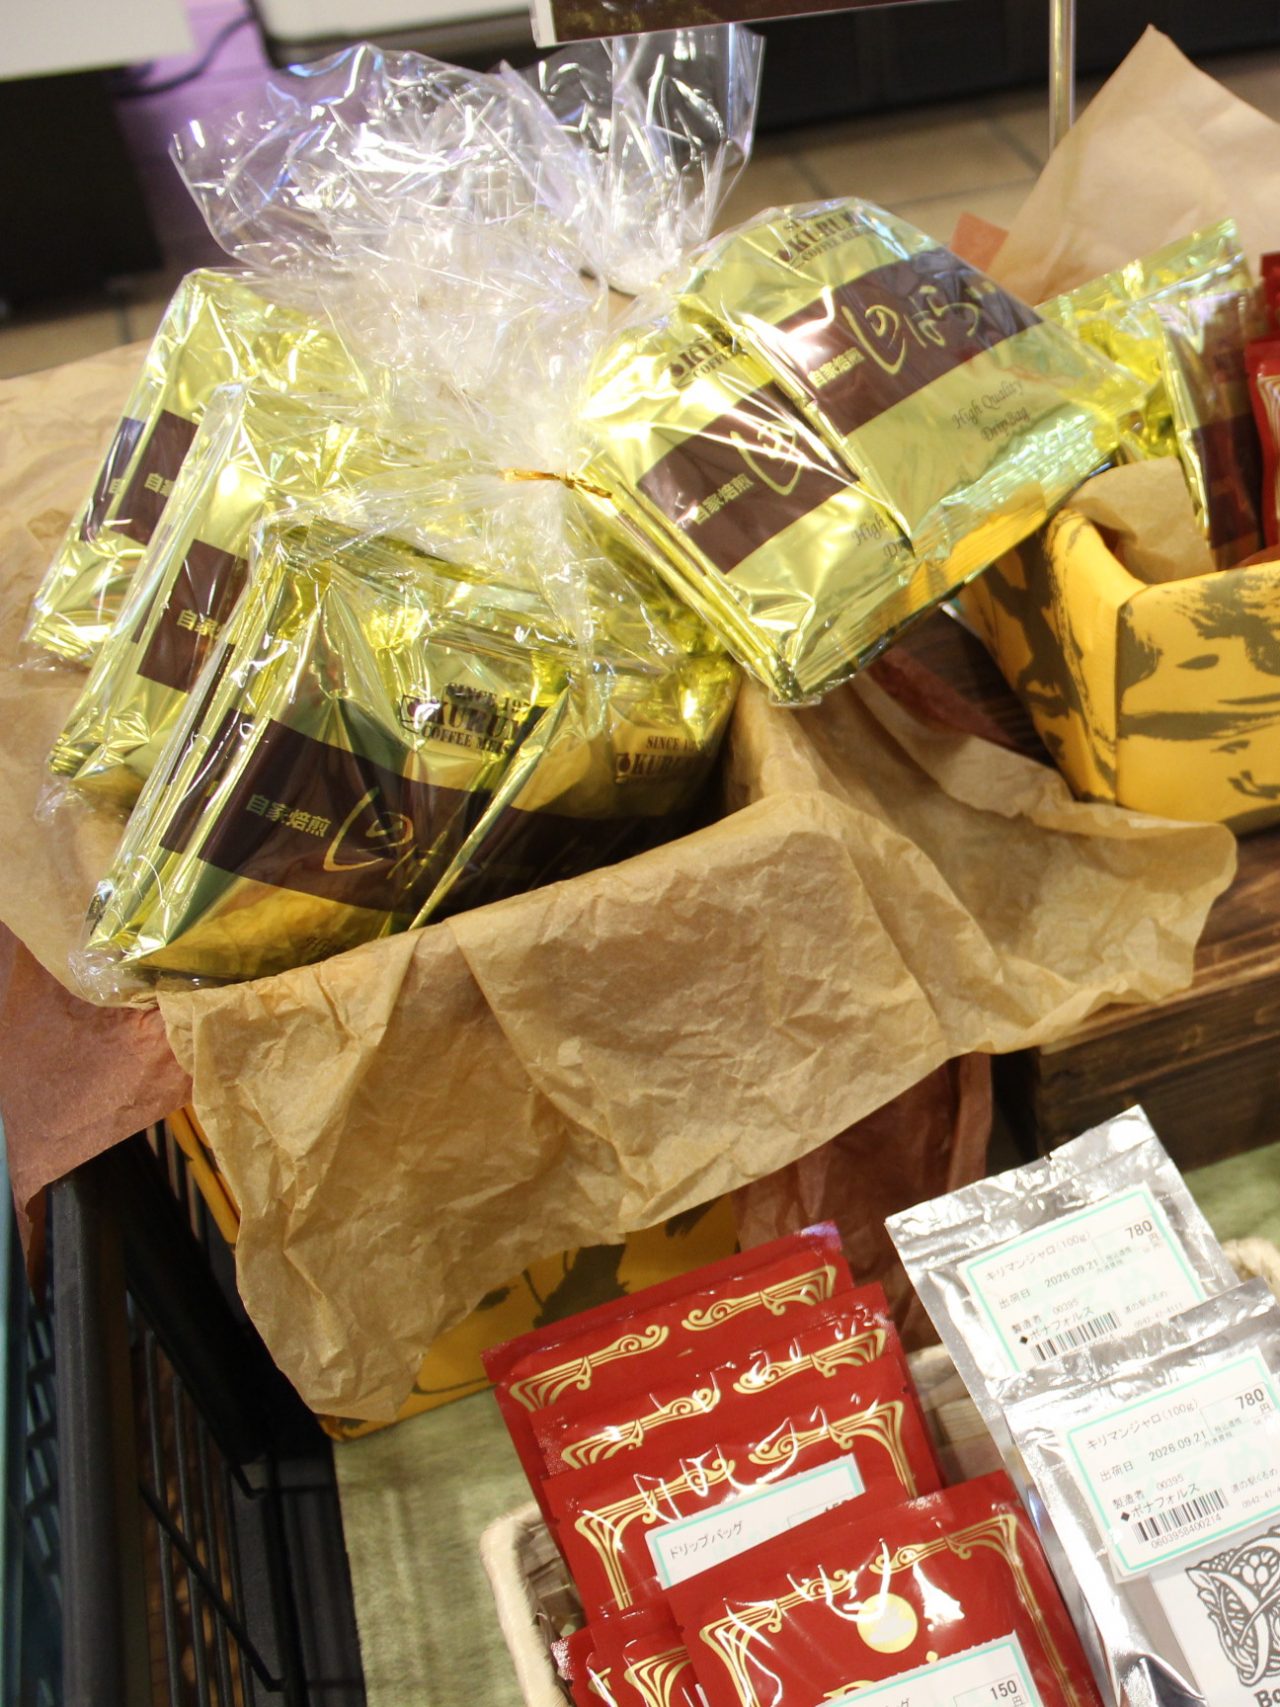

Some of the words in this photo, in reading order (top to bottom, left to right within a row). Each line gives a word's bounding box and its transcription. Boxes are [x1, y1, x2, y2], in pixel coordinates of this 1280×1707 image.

[952, 400, 983, 429] High
[981, 380, 1024, 410] Quality
[421, 724, 473, 748] COFFEE
[246, 794, 332, 838] 自家焙煎
[1124, 1218, 1154, 1240] 780
[1234, 1387, 1267, 1410] 780
[1098, 1460, 1135, 1482] 出荷日
[1111, 1488, 1146, 1510] 製造者
[669, 1521, 744, 1561] ドリップバッグ
[988, 1679, 1018, 1701] 150
